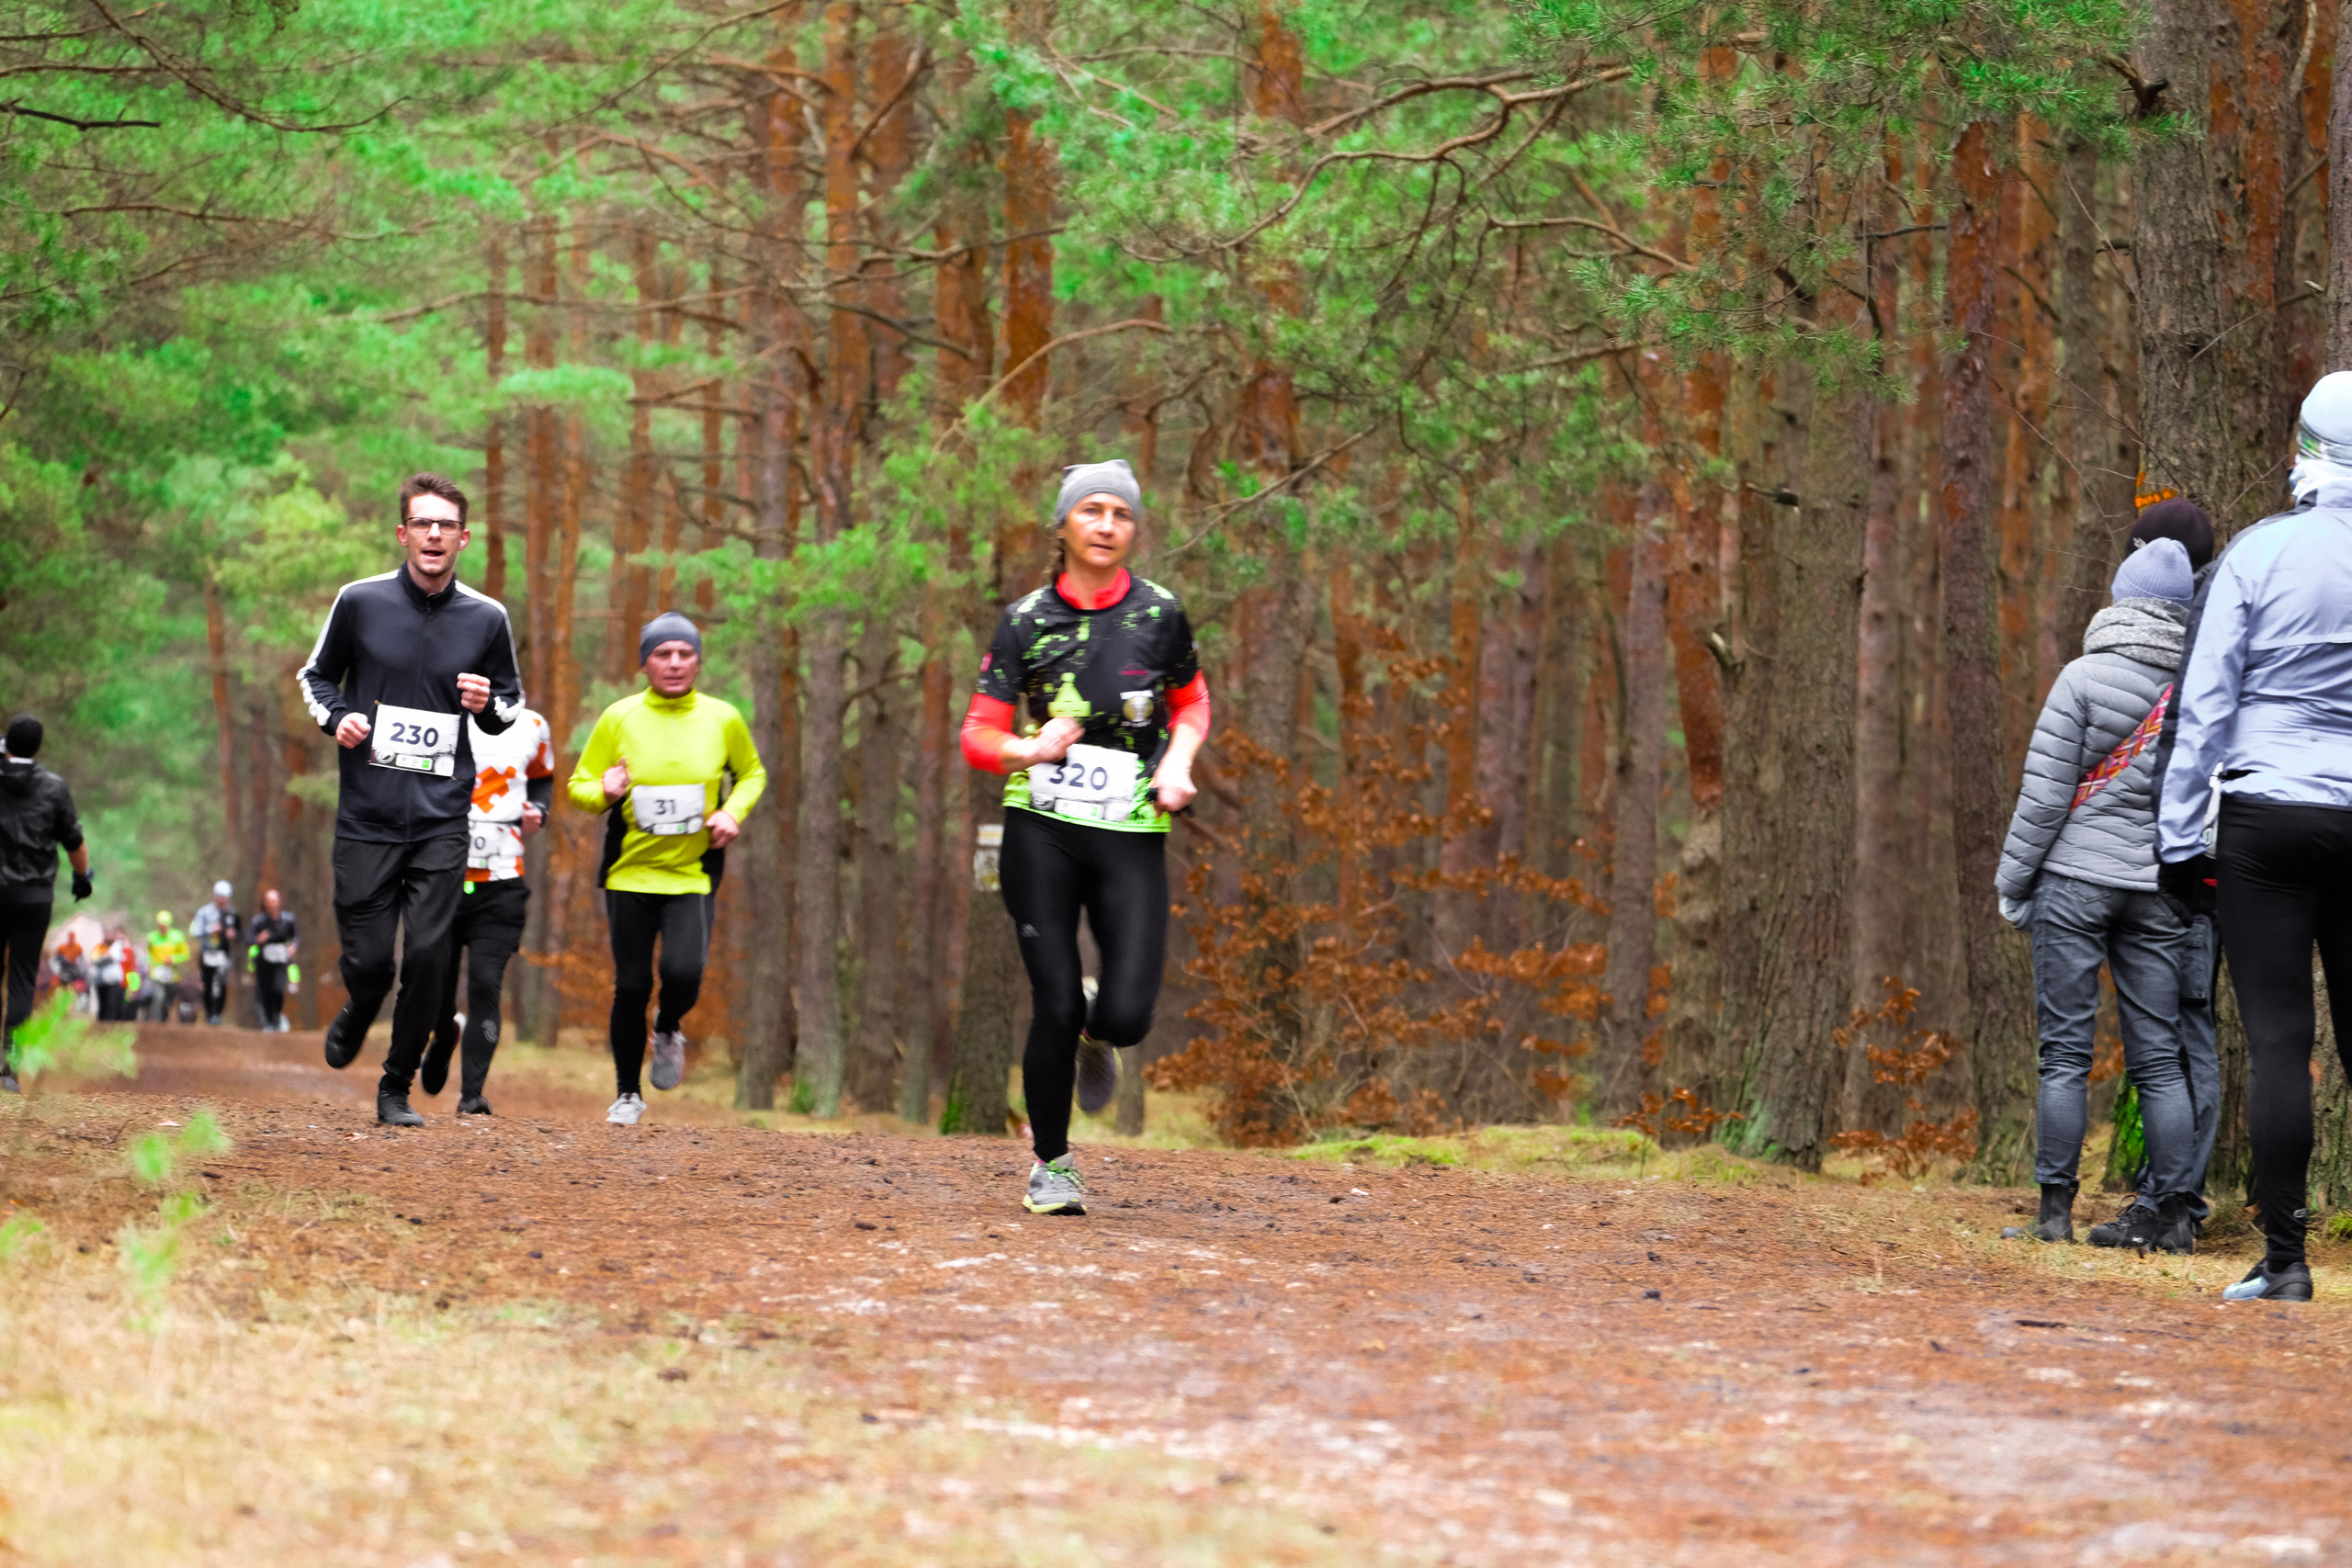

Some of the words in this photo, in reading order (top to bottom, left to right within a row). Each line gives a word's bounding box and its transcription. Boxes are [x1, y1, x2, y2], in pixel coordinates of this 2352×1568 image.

[390, 722, 439, 748] 230
[1049, 762, 1107, 791] 320
[655, 799, 676, 816] 31
[474, 836, 486, 851] 0
